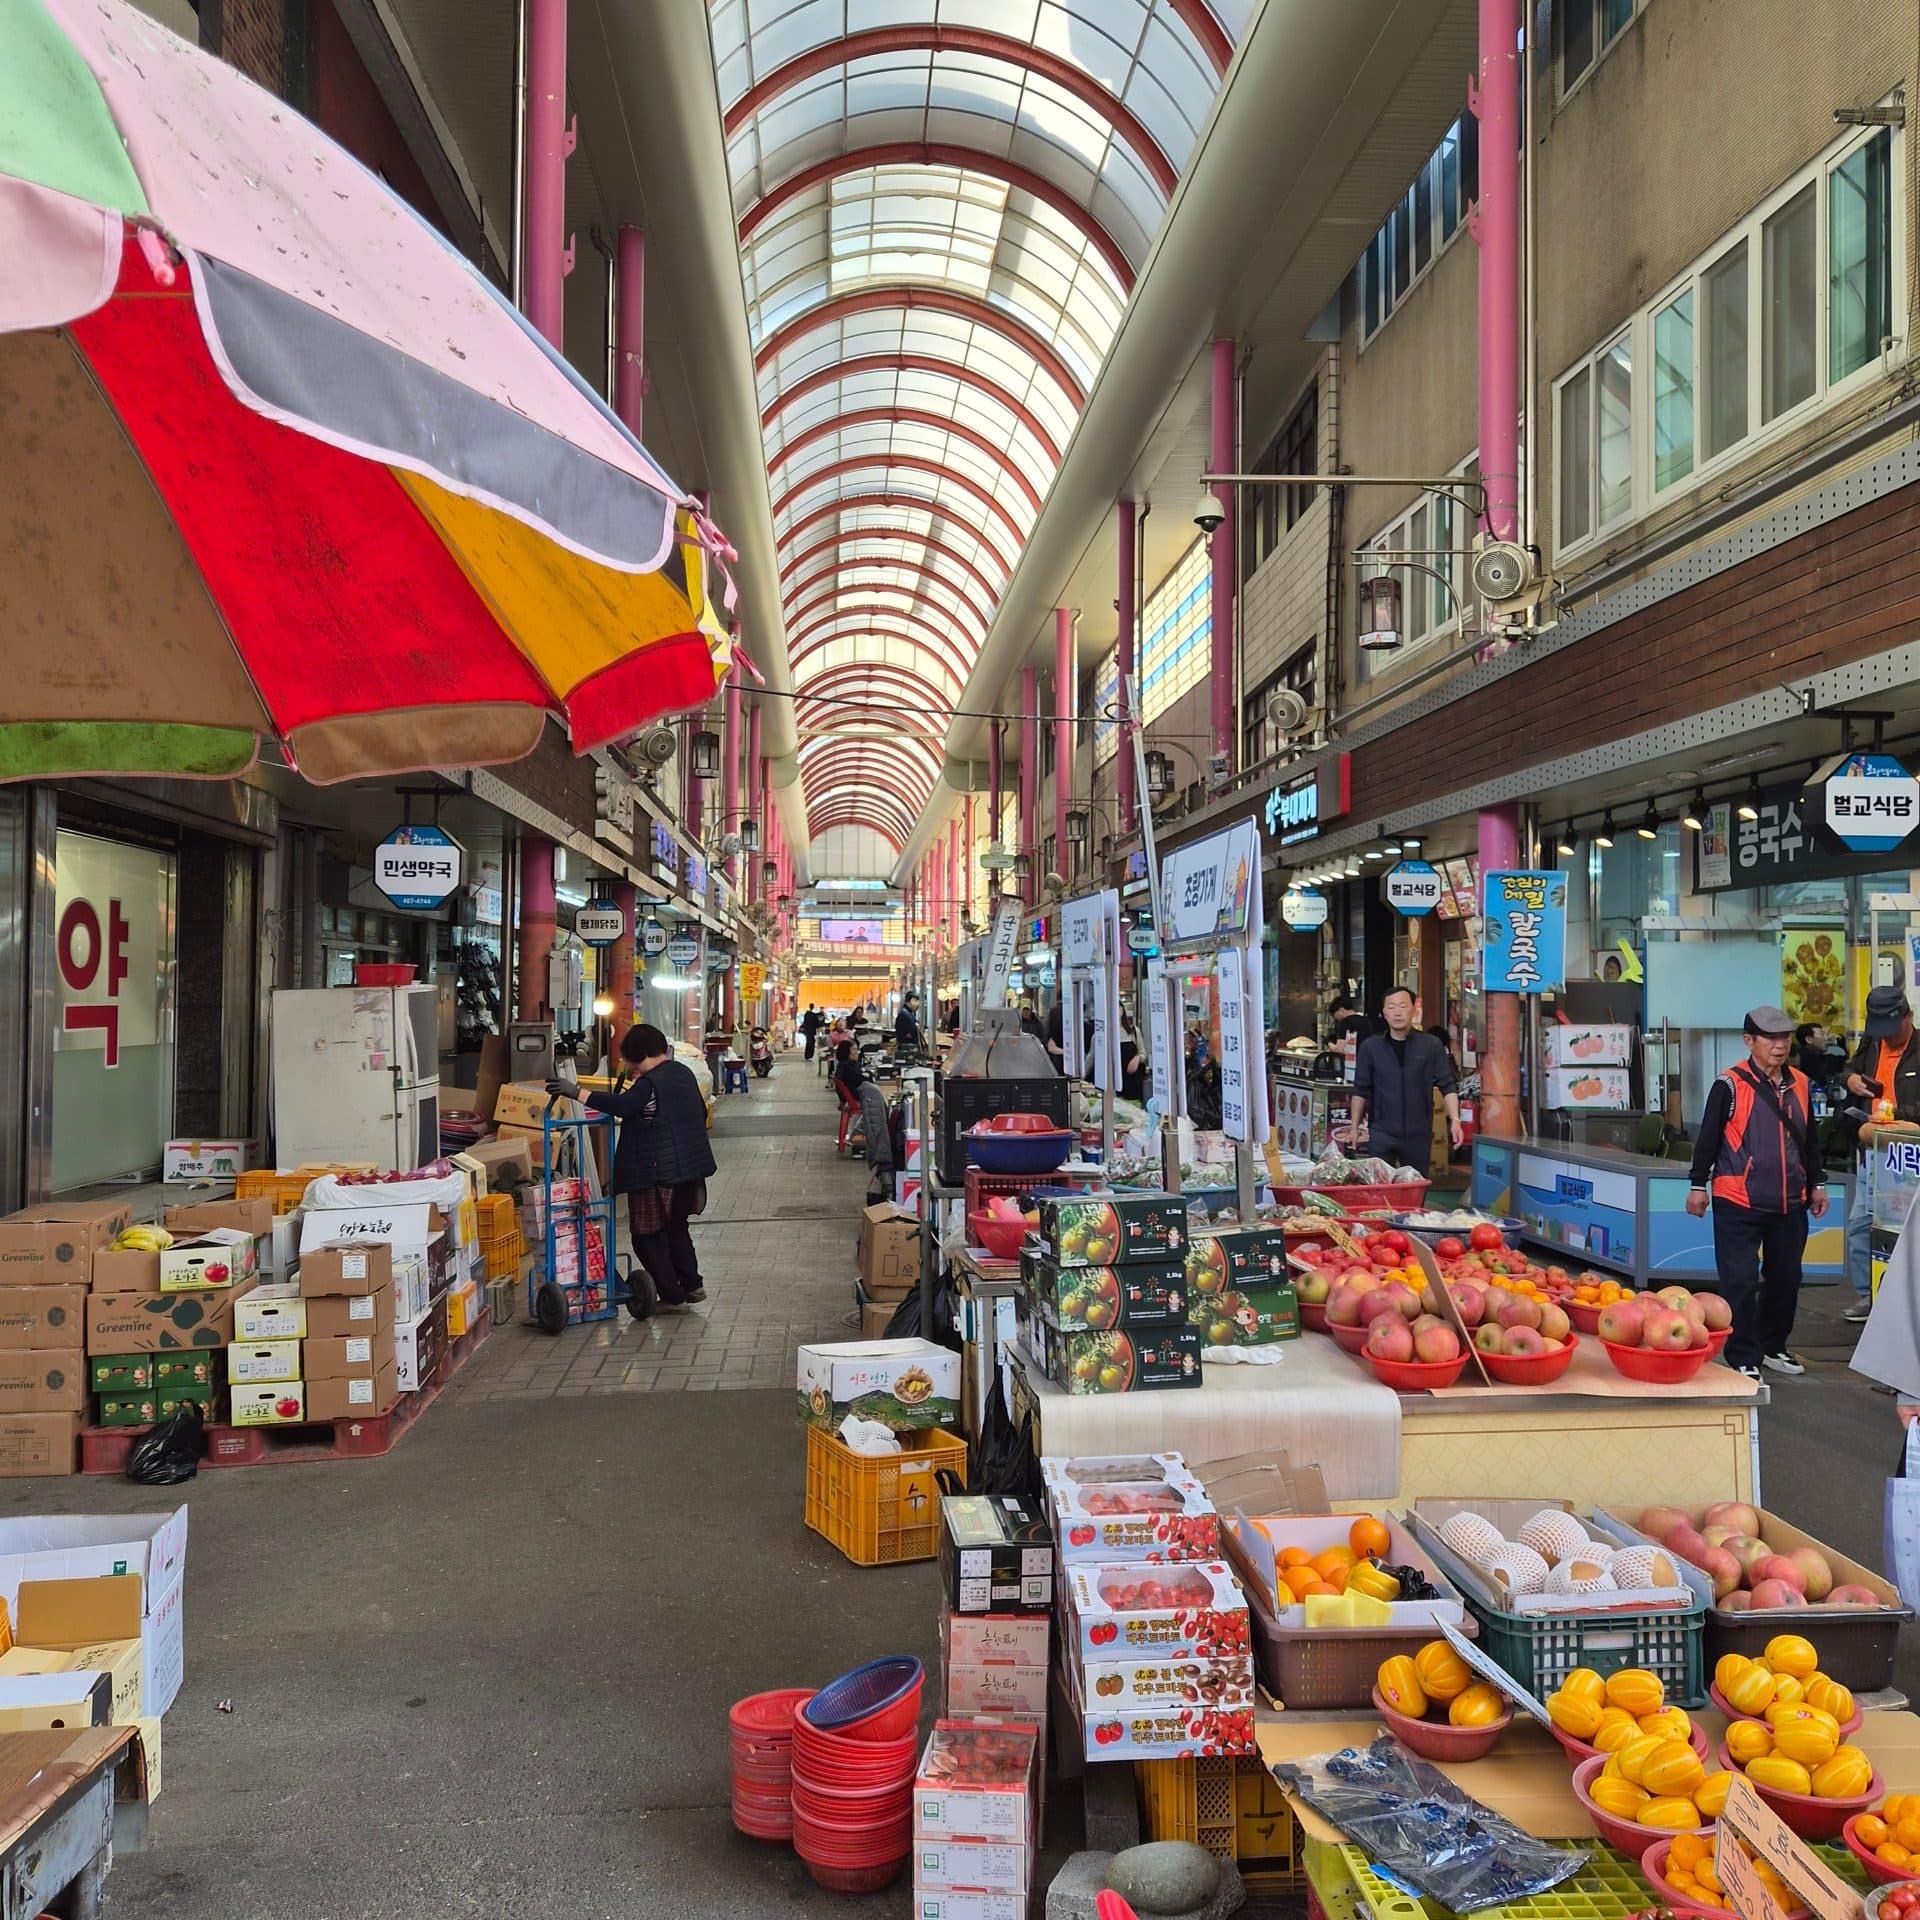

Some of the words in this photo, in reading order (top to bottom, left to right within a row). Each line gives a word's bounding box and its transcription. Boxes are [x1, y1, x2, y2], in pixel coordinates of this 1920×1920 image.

[1834, 796, 1913, 817] 벌교식당
[384, 860, 452, 879] 민생약국
[1392, 884, 1436, 897] 벌교식당
[581, 919, 618, 930] 형제닭집
[995, 915, 1017, 976] 군고구마
[1505, 911, 1543, 988] 칼국수
[58, 897, 130, 1070] 약
[96, 1321, 152, 1334] Greenine
